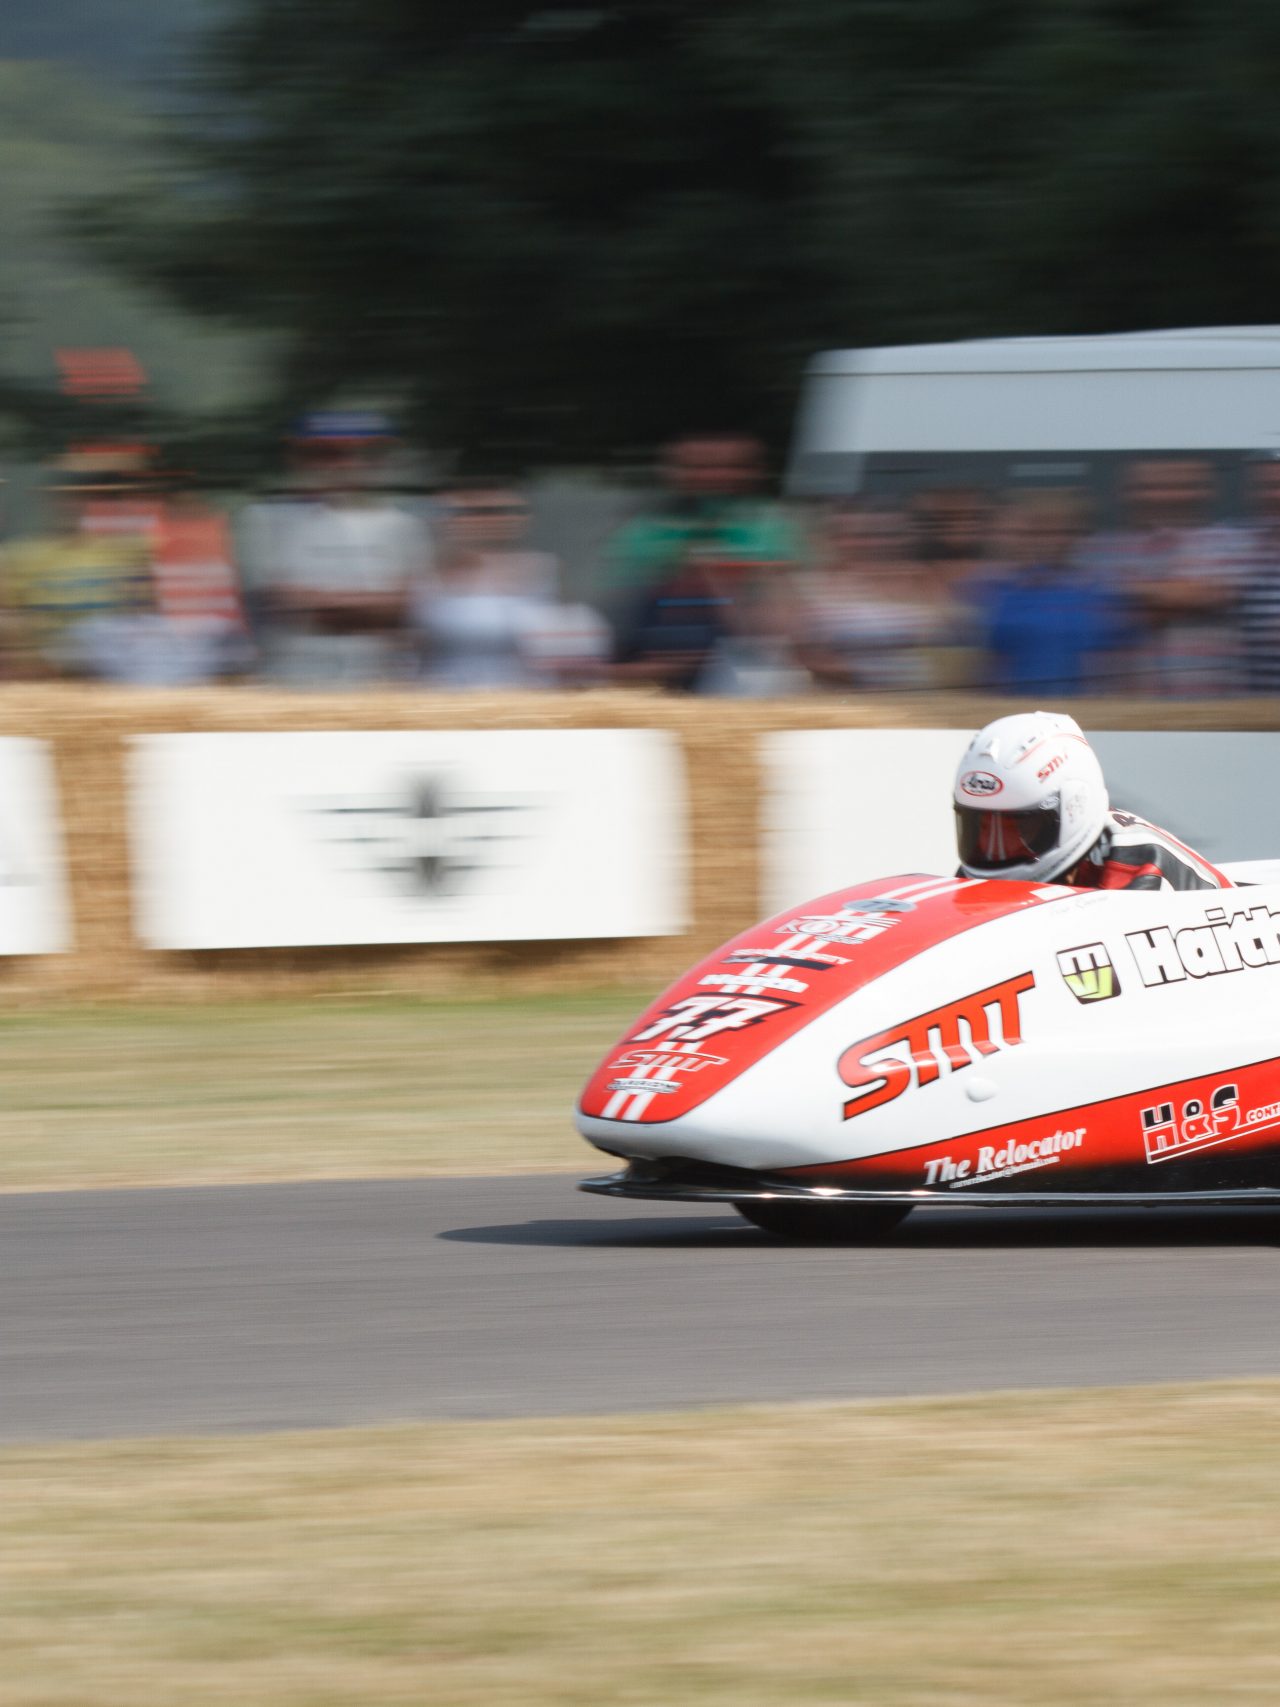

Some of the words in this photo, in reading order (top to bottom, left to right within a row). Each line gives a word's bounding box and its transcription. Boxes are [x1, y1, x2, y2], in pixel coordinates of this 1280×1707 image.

[615, 992, 804, 1044] 77
[923, 1156, 971, 1185] The
[975, 1128, 1087, 1175] Relocator
